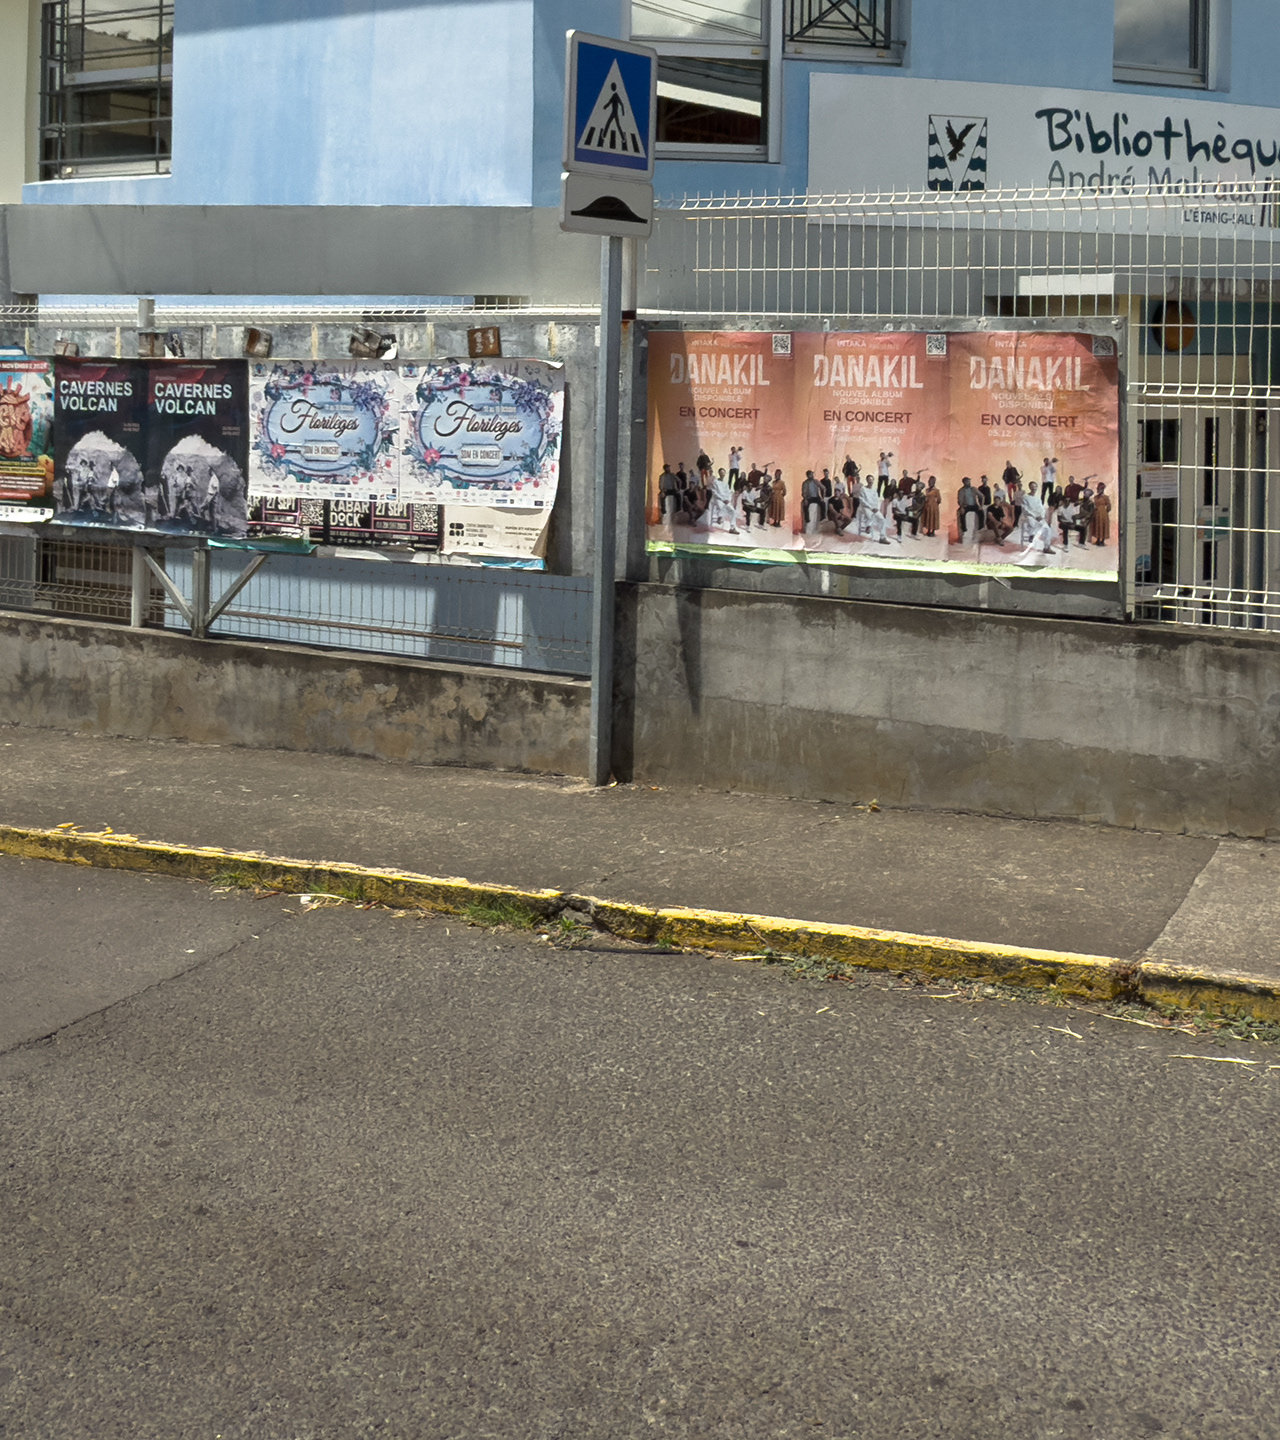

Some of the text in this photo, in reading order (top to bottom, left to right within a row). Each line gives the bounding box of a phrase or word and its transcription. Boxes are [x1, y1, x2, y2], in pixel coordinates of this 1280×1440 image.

[1048, 159, 1256, 203] André Malraux
[670, 352, 770, 386] DANAKIL
[813, 354, 924, 388] DANAKIL
[970, 355, 1090, 391] DANAKIL
[60, 380, 133, 397] CAVERNES
[154, 382, 232, 399] CAVERNES
[723, 387, 751, 395] ALBUM
[833, 389, 903, 398] NOUVEL ALBUM
[60, 395, 118, 412] VOLCAN
[155, 398, 216, 415] VOLCAN
[693, 394, 743, 403] DISPONIBLE
[839, 397, 893, 406] DISPONIBLE
[280, 398, 359, 438] Florilèges
[434, 400, 522, 441] Florilèges
[679, 406, 760, 419] EN CONCERT
[823, 410, 912, 423] EN CONCERT
[981, 414, 1078, 427] EN CONCERT
[330, 500, 369, 514] KABAR
